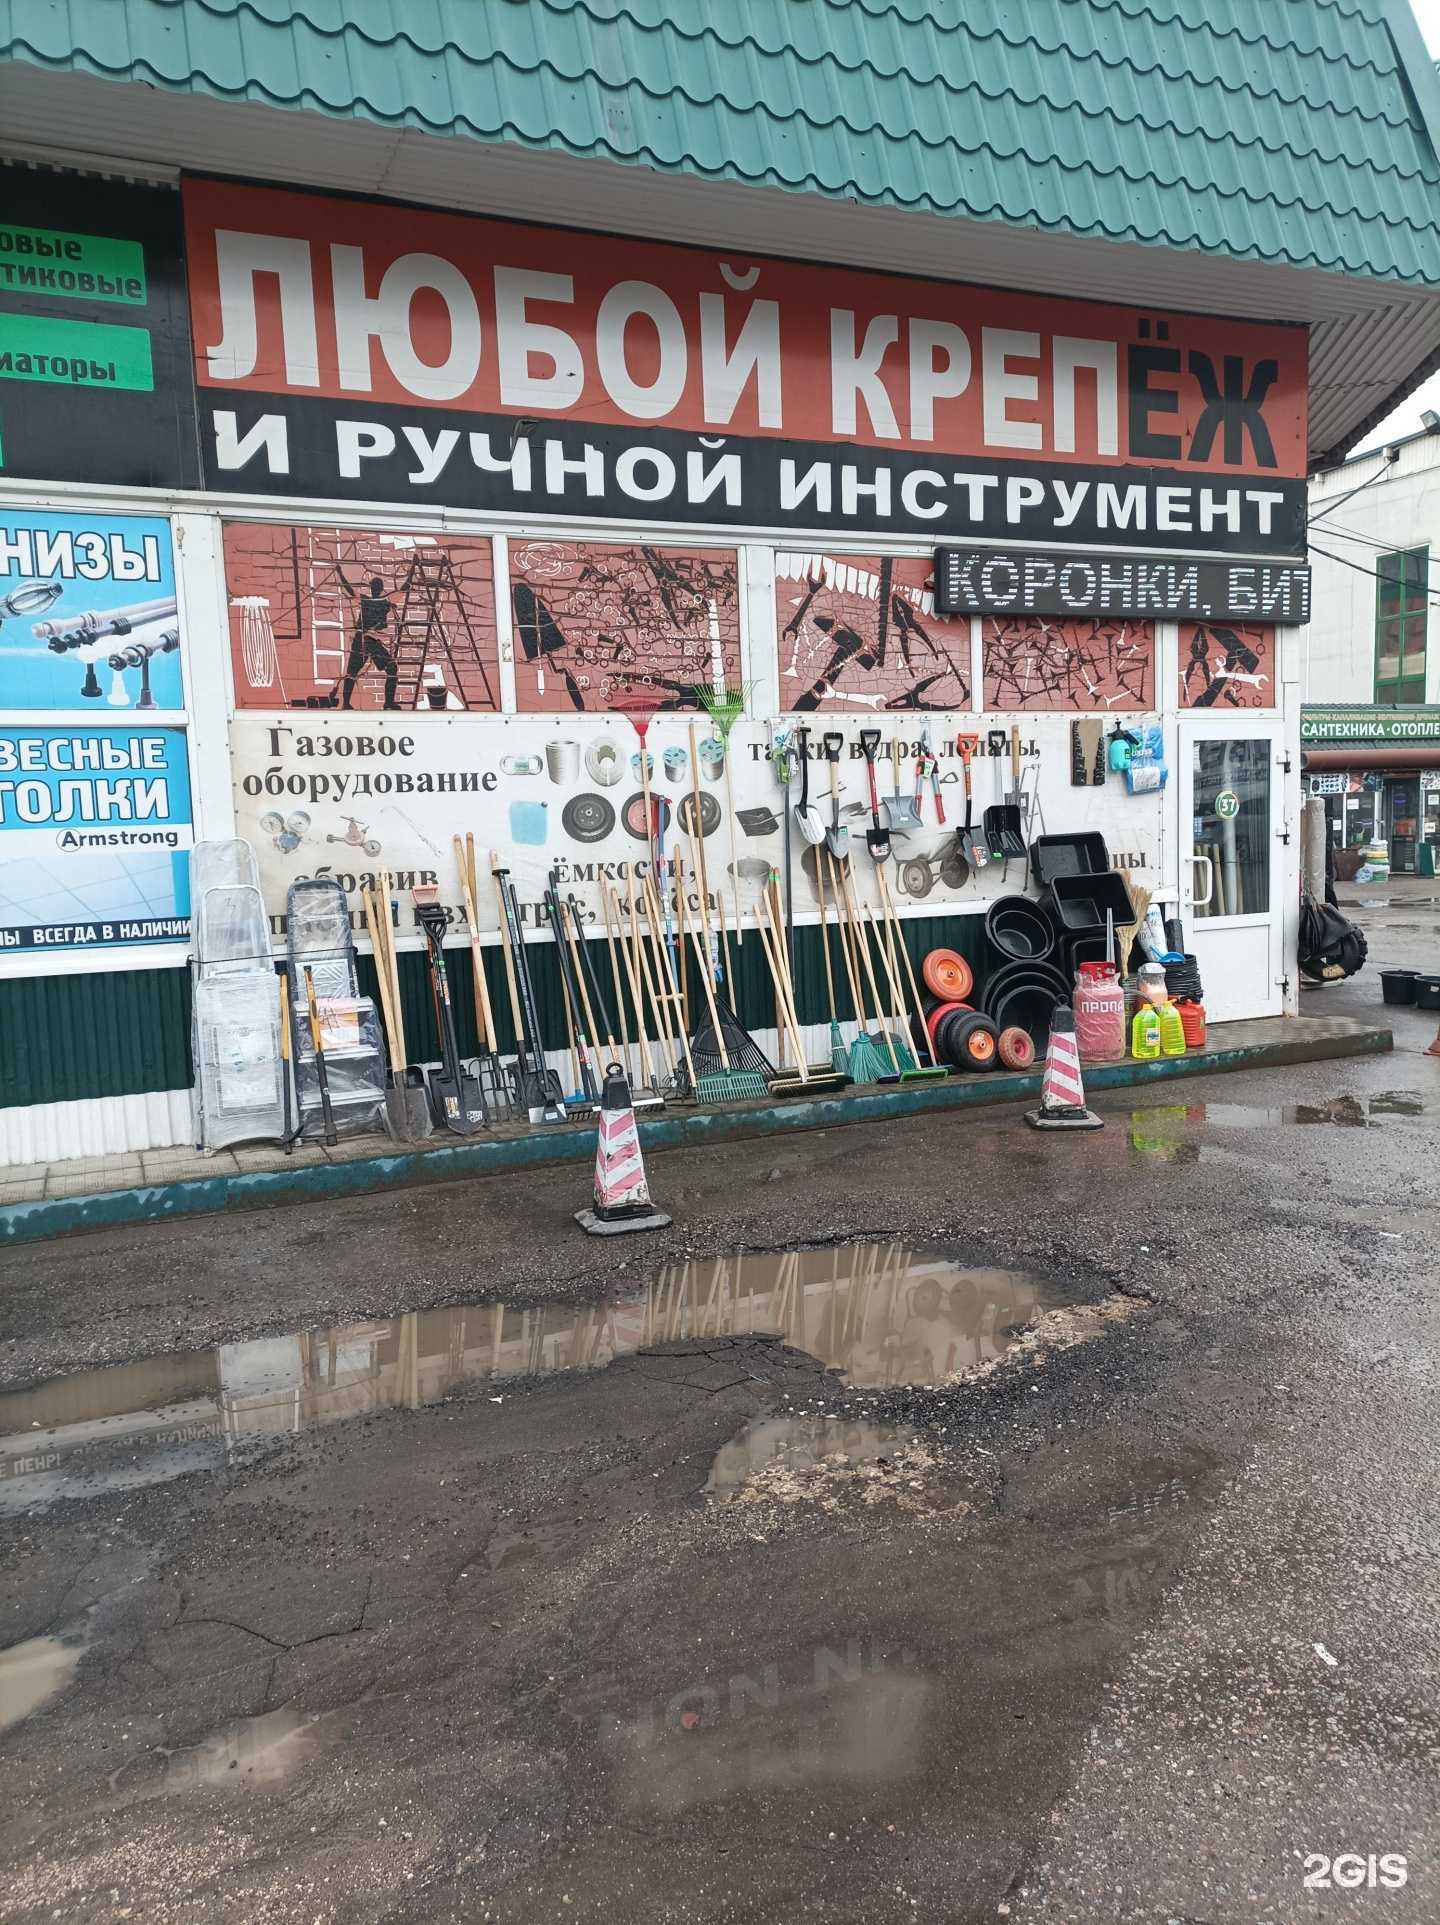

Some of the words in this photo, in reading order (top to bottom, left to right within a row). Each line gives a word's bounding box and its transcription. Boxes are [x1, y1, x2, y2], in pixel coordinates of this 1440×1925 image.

[207, 229, 782, 429] ЛЮБОЙ
[830, 308, 1278, 468] КРЕПЁЖ
[212, 410, 290, 475] И
[335, 420, 741, 507] РУЧНОЙ
[780, 458, 1284, 534] ИНСТРУМЕНТ
[0, 527, 161, 582] НИЗЫ
[268, 727, 415, 757] Газовое
[1301, 722, 1385, 737] САНТЕХНИКА
[1391, 721, 1440, 736] ОТОПЛЕ
[242, 763, 498, 802] оборудование
[1221, 798, 1236, 812] 37
[60, 831, 178, 847] Armstrong
[33, 925, 97, 944] ВСЕГДА
[102, 923, 115, 940] В
